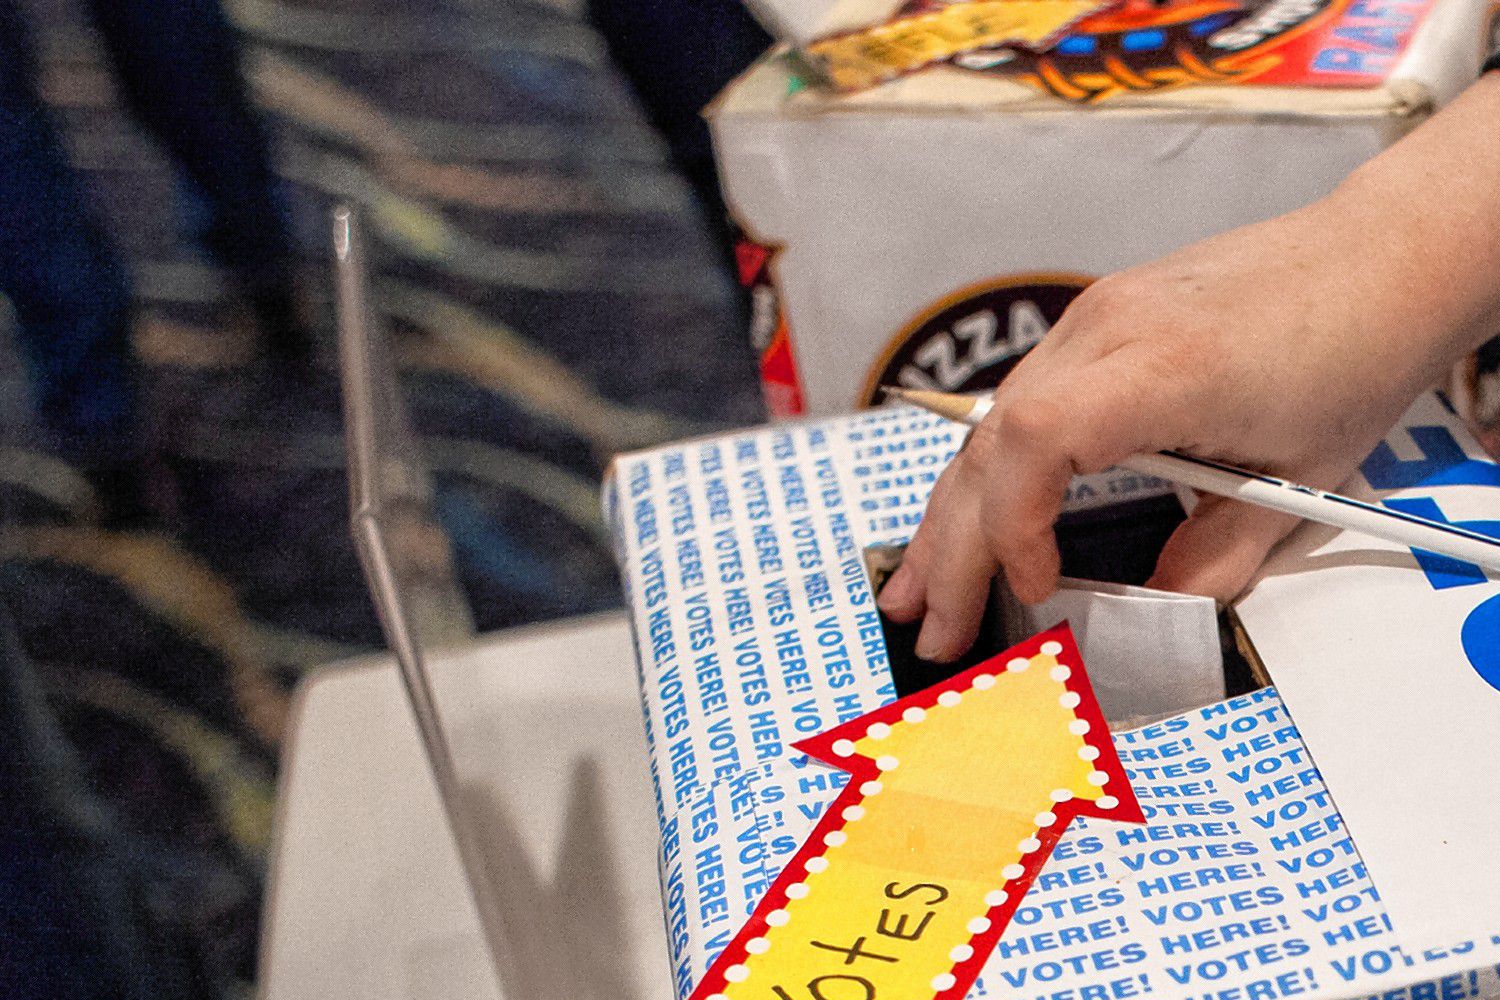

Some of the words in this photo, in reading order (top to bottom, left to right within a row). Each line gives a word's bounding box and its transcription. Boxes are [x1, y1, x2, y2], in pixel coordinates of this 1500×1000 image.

[677, 538, 704, 590] HERE!
[714, 527, 745, 583] VOTES
[790, 515, 823, 569] VOTES
[641, 546, 667, 607] VOTES
[764, 577, 795, 627] VOTES
[803, 571, 835, 613] HERE!
[649, 606, 676, 668] HERE!
[685, 591, 715, 651] VOTES
[723, 587, 755, 636] HERE!
[734, 637, 771, 706] VOTES
[774, 628, 813, 695] HERE!
[814, 615, 856, 689] VOTES
[854, 610, 889, 677] HERE!
[658, 665, 690, 739] VOTES
[694, 652, 728, 716] HERE!
[748, 710, 784, 764] HER
[1116, 821, 1241, 847] HERE!
[1119, 841, 1259, 873] VOTES
[695, 844, 729, 929] HERE!
[1137, 862, 1267, 898] HERE!
[667, 862, 691, 962] VOTES
[998, 915, 1129, 959] HERE!
[1140, 886, 1285, 927] VOTES
[1000, 942, 1148, 988] VOTES
[1160, 914, 1291, 956] HERE!
[1165, 937, 1311, 985] VOTES
